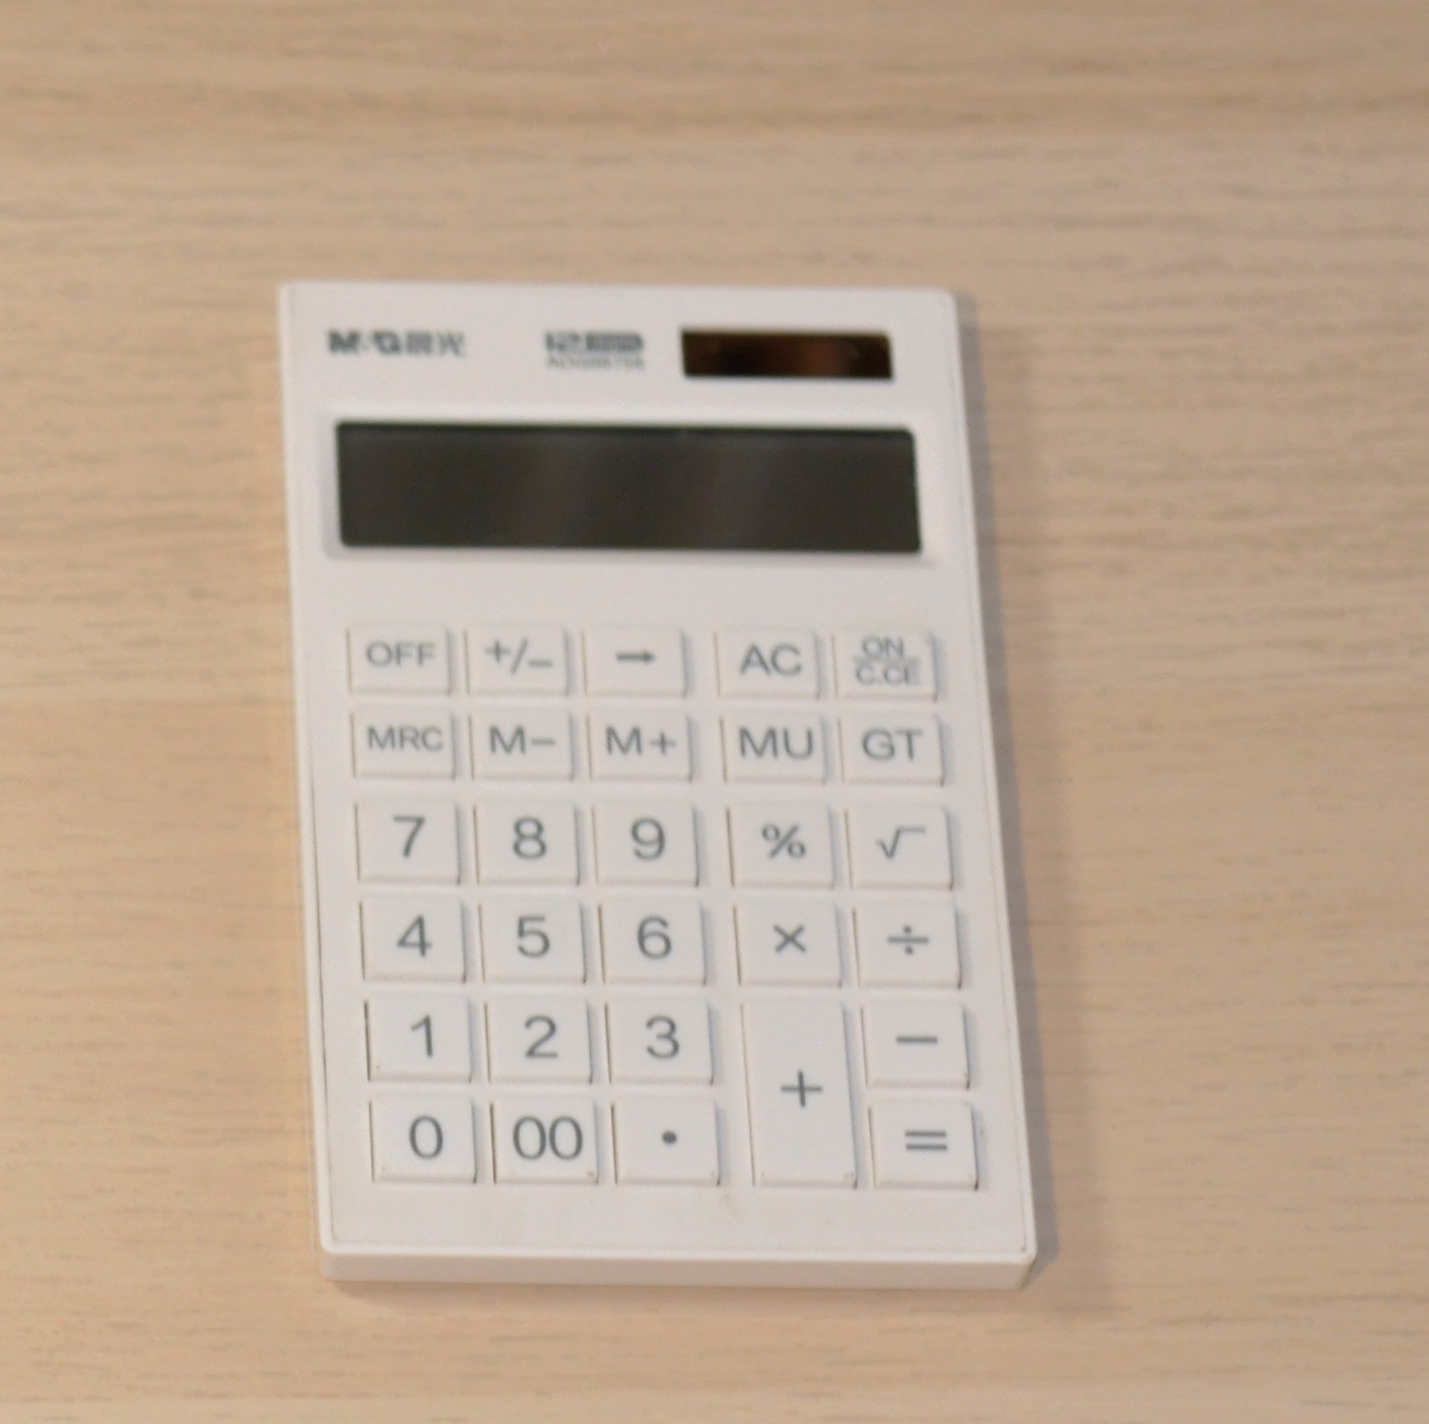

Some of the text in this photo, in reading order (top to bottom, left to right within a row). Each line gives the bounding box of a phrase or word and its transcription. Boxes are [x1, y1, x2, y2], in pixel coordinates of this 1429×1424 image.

[364, 640, 435, 667] OFF
[739, 643, 803, 677] AC
[861, 636, 906, 659] ON
[366, 725, 444, 752] MRC
[605, 725, 676, 755] M+
[738, 726, 815, 760] MU
[860, 728, 922, 761] GT
[393, 814, 426, 859] 7
[511, 816, 548, 860] 8
[630, 817, 667, 861] 9
[760, 824, 807, 859] %
[396, 914, 432, 958] 4
[516, 915, 551, 959] 5
[636, 915, 673, 960] 6
[411, 1014, 434, 1058] 1
[524, 1014, 558, 1059] 2
[645, 1015, 681, 1060] 3
[408, 1115, 445, 1160] 0
[512, 1115, 584, 1161] 00
